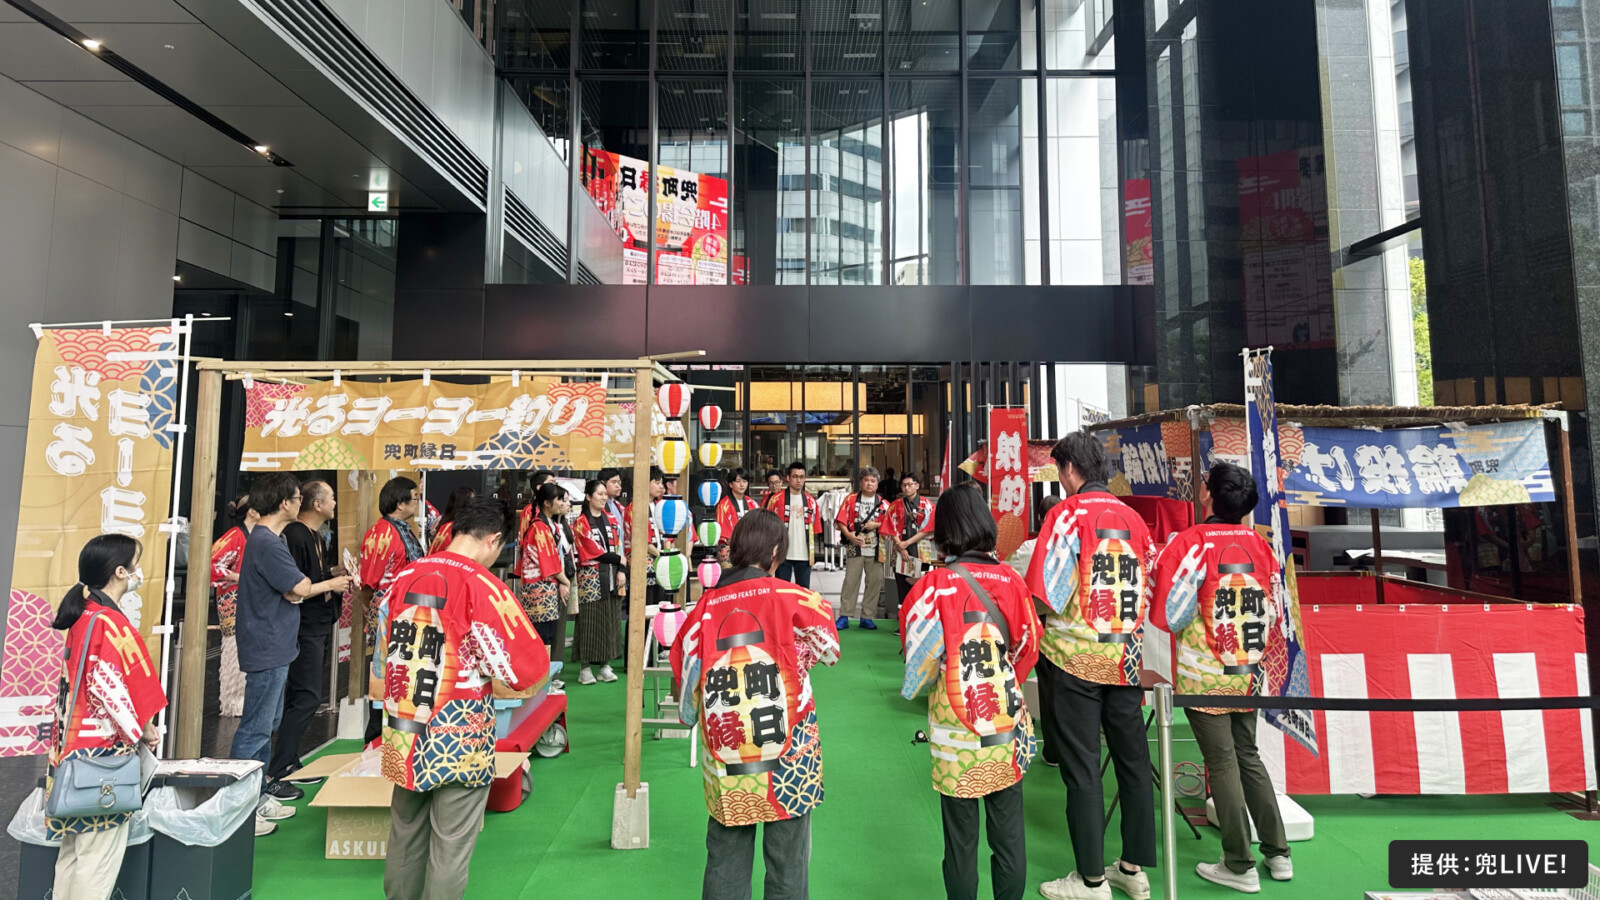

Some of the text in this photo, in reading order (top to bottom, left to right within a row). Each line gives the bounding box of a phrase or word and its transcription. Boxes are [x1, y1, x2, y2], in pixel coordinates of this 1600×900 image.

[260, 393, 588, 438] 光るヨーヨー釣り
[384, 442, 458, 461] 兜町縁日
[995, 430, 1026, 517] 射的
[445, 558, 463, 568] FEAST
[461, 563, 476, 573] DAY
[982, 571, 1000, 581] FEAST
[1091, 551, 1140, 587] 兜町
[737, 588, 757, 599] FEAST
[757, 586, 771, 596] DAY
[1087, 588, 1139, 623] 縁日
[1214, 585, 1267, 620] 兜町
[387, 618, 446, 668] 兜町
[1215, 620, 1267, 656] 縁日
[384, 661, 439, 711] 縁日
[705, 660, 781, 709] 兜町
[707, 704, 788, 752] 縁日
[329, 839, 387, 857] ASKUL
